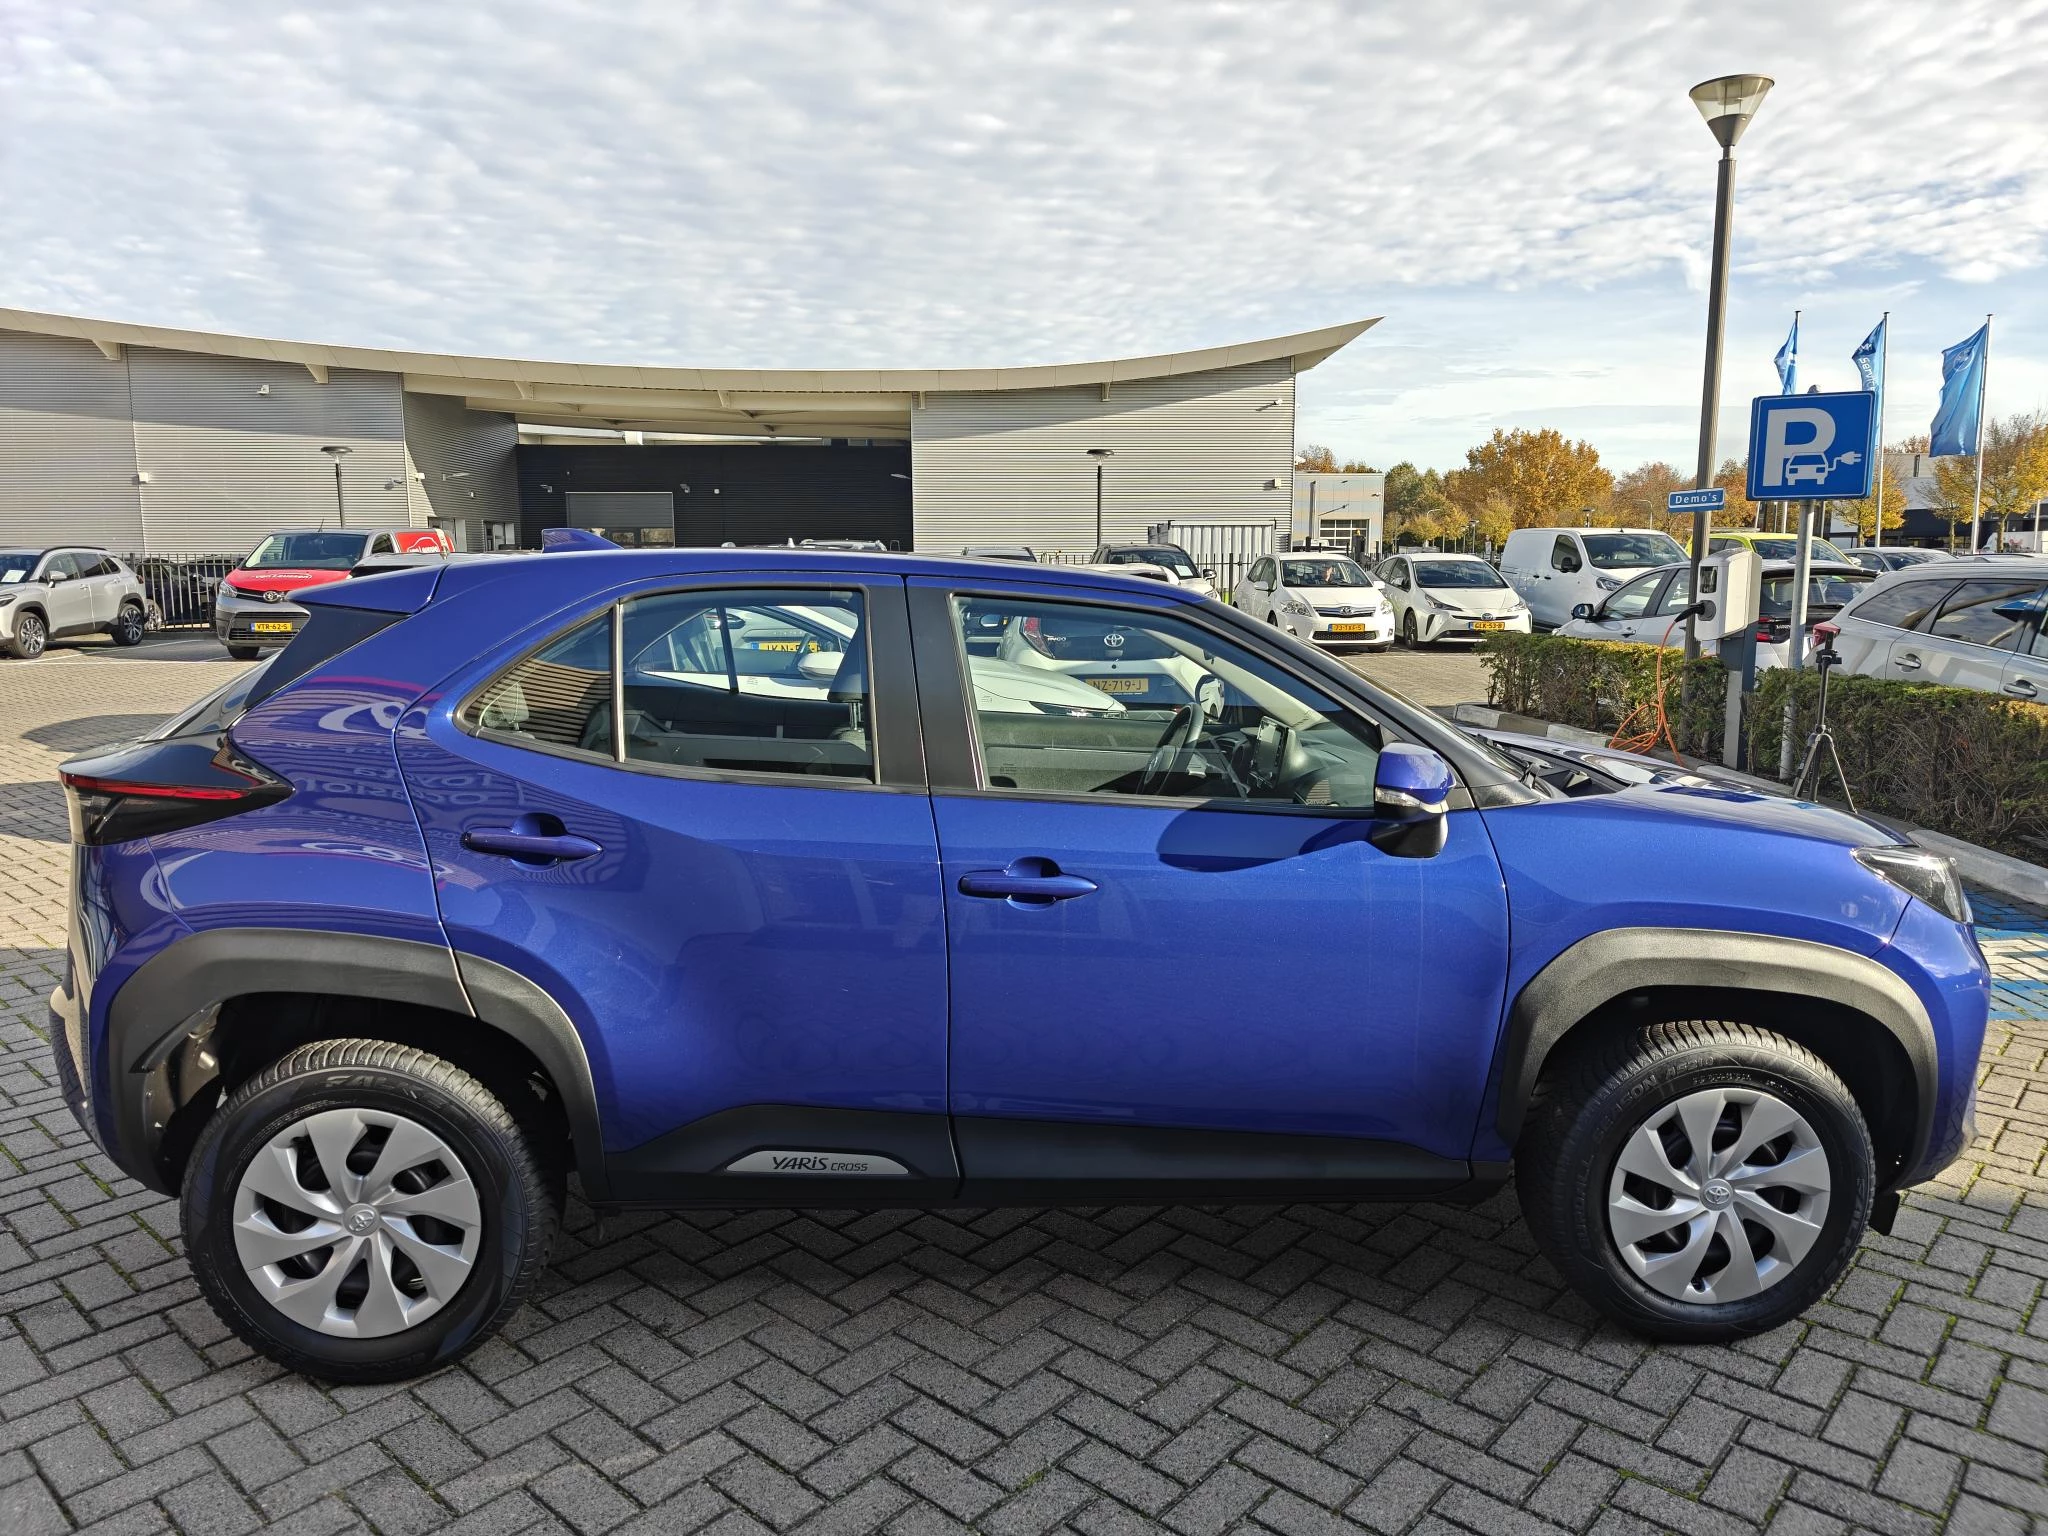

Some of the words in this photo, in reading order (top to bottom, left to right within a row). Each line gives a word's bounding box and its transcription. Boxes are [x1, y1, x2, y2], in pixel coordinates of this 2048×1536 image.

[1763, 407, 1835, 486] P
[1675, 492, 1718, 504] Demo's
[256, 622, 288, 631] VTR-62-S
[1092, 679, 1143, 691] NZ-719-J
[830, 1162, 869, 1172] CROSS
